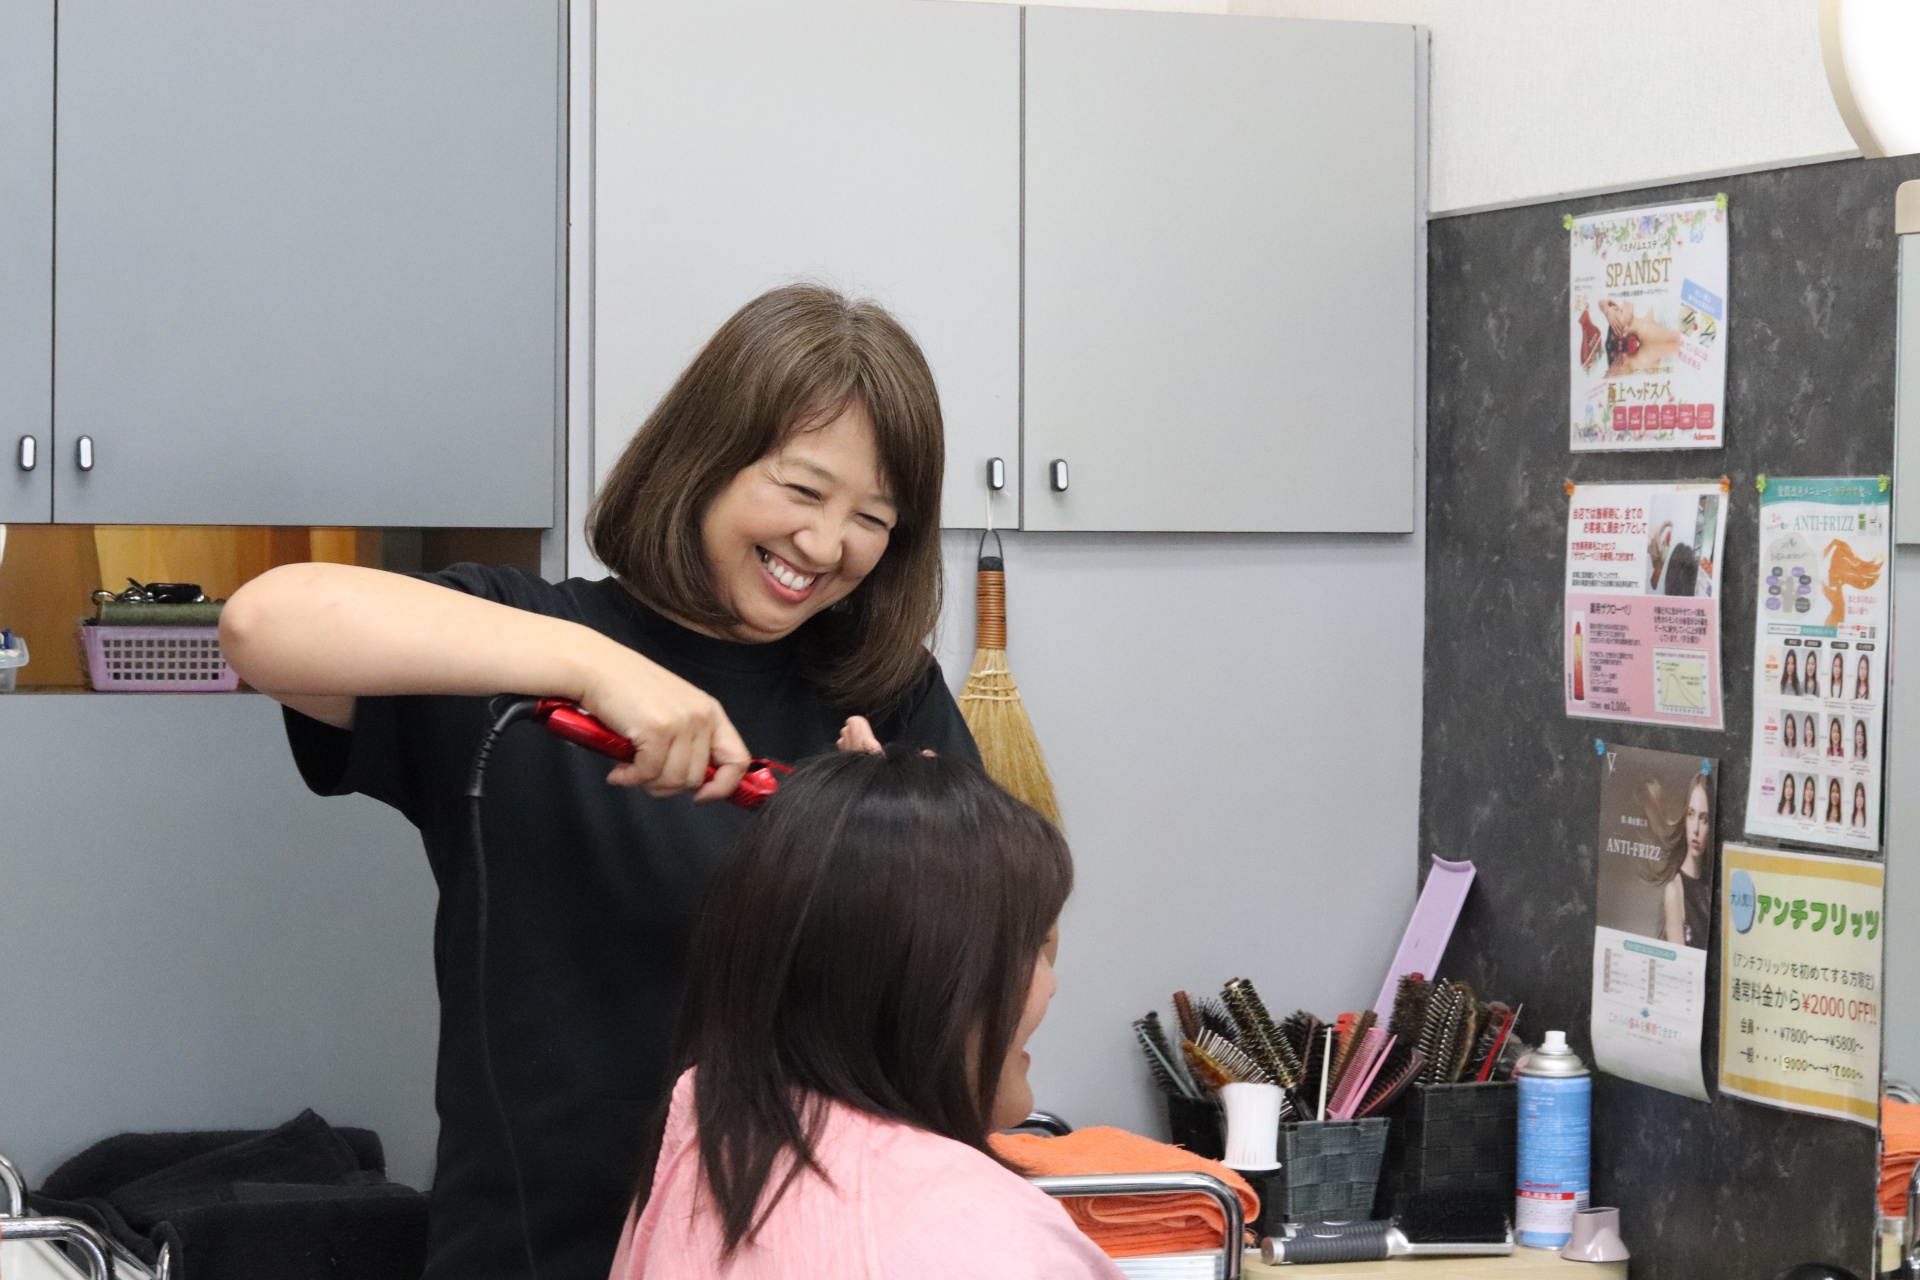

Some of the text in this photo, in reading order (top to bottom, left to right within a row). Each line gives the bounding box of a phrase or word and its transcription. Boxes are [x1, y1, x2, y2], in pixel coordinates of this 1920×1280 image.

[1606, 257, 1672, 288] SPANIST
[1608, 380, 1672, 403] 極上ヘッドスパ
[1793, 515, 1855, 532] ANTI-FRIZZ
[1606, 838, 1662, 861] ANTI-FRIZZ
[1757, 894, 1880, 941] アンチフリッツ
[1849, 999, 1878, 1026] OFF!!
